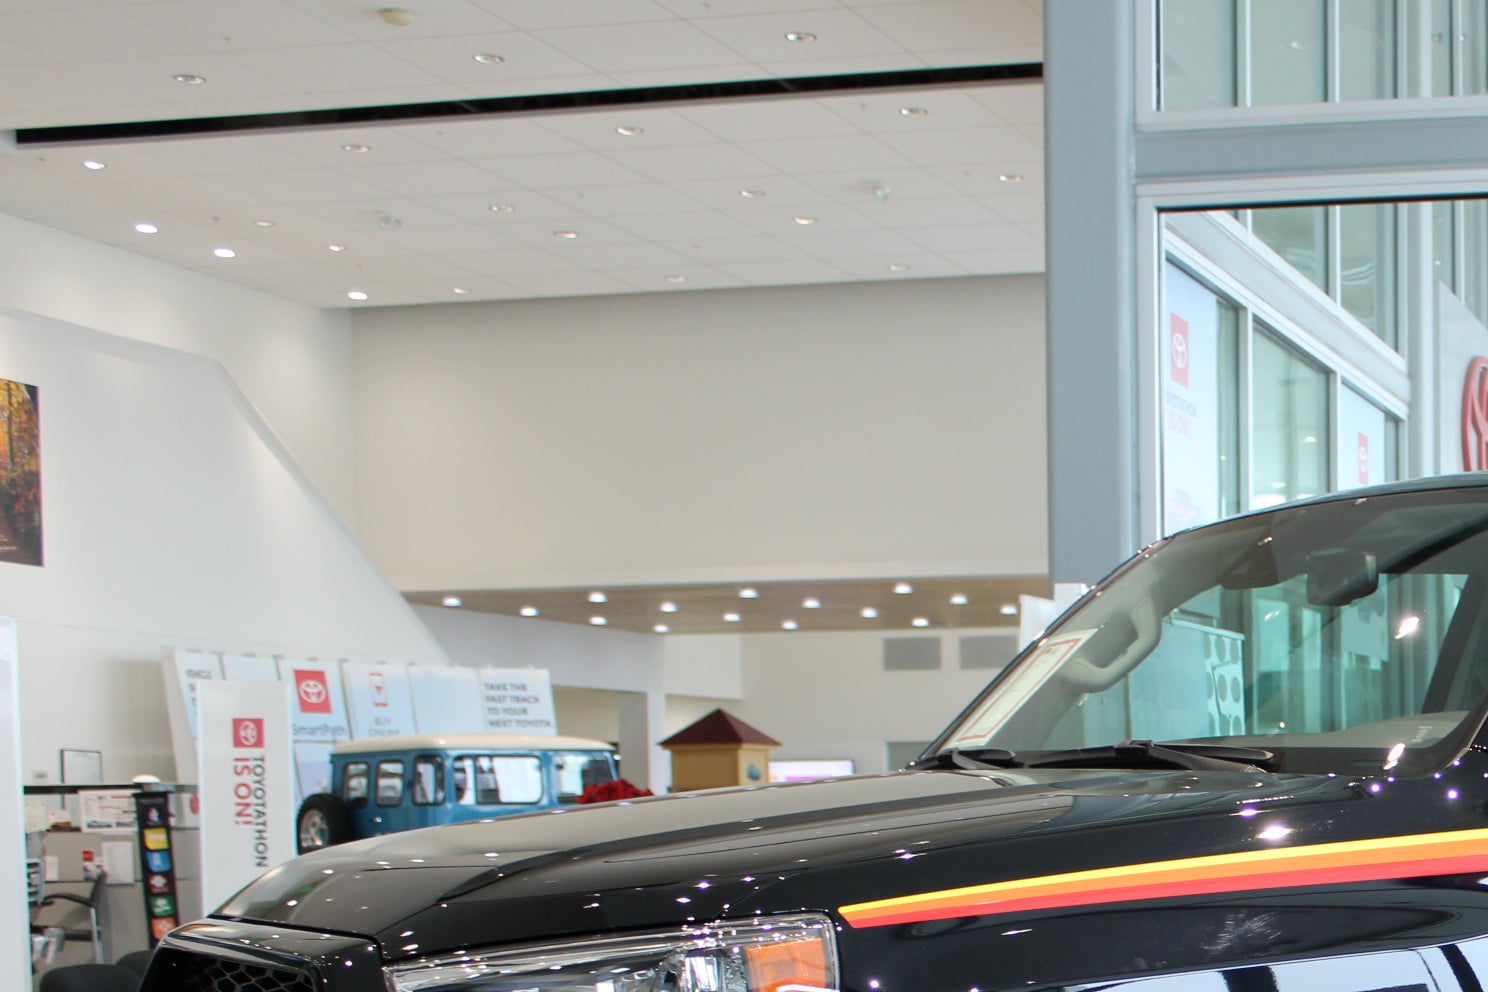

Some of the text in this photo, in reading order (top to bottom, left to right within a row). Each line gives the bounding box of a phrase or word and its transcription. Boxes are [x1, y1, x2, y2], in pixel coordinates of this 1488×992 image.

[510, 684, 528, 692] THE
[487, 707, 528, 716] TO YOUR
[488, 719, 513, 728] NEXT
[233, 756, 253, 825] IS ON!
[252, 755, 269, 868] TOYOTATHON
